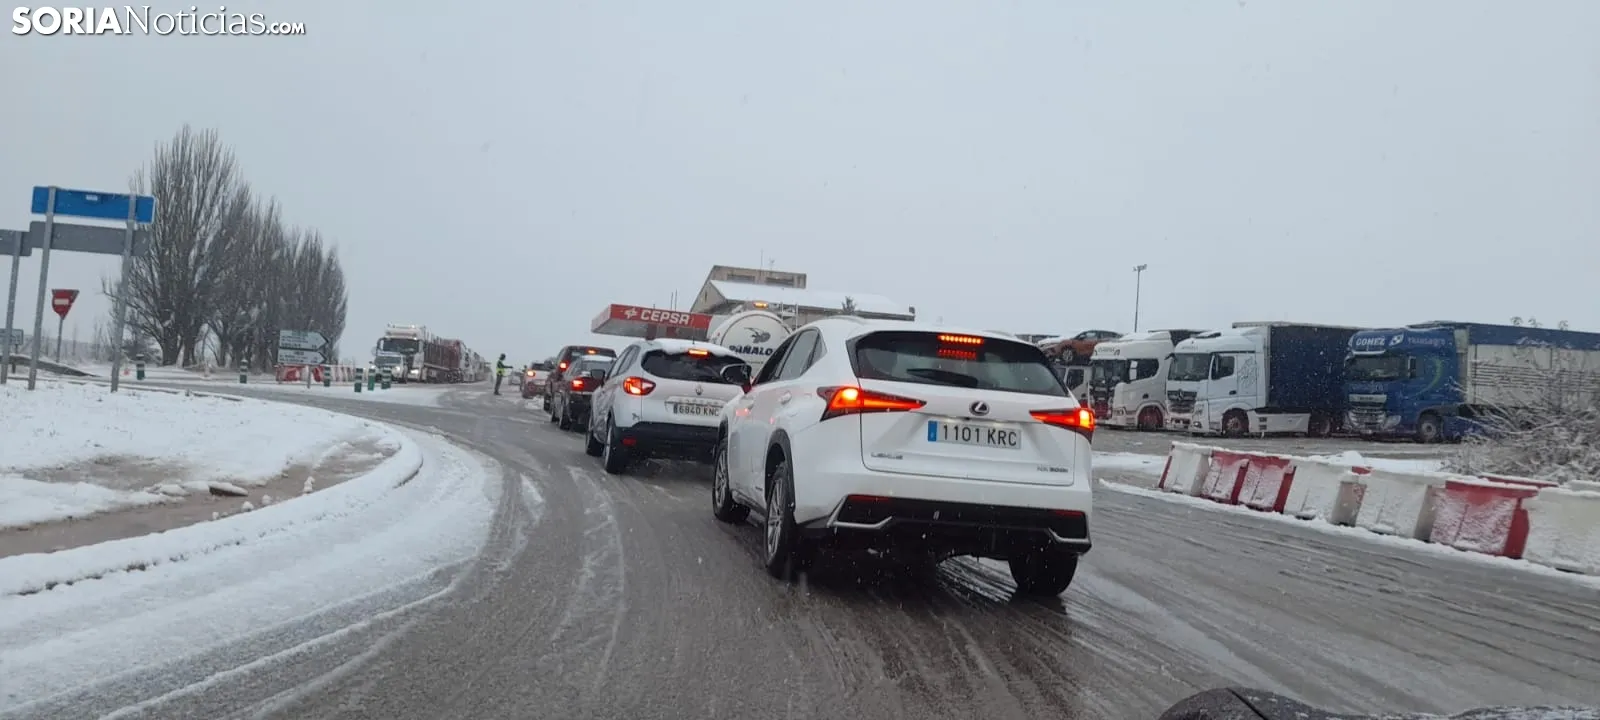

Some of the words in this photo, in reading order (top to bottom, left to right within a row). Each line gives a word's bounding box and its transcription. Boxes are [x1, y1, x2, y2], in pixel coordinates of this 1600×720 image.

[640, 309, 690, 325] CEPSA
[943, 424, 981, 443] 1101
[987, 429, 1018, 447] KRC
